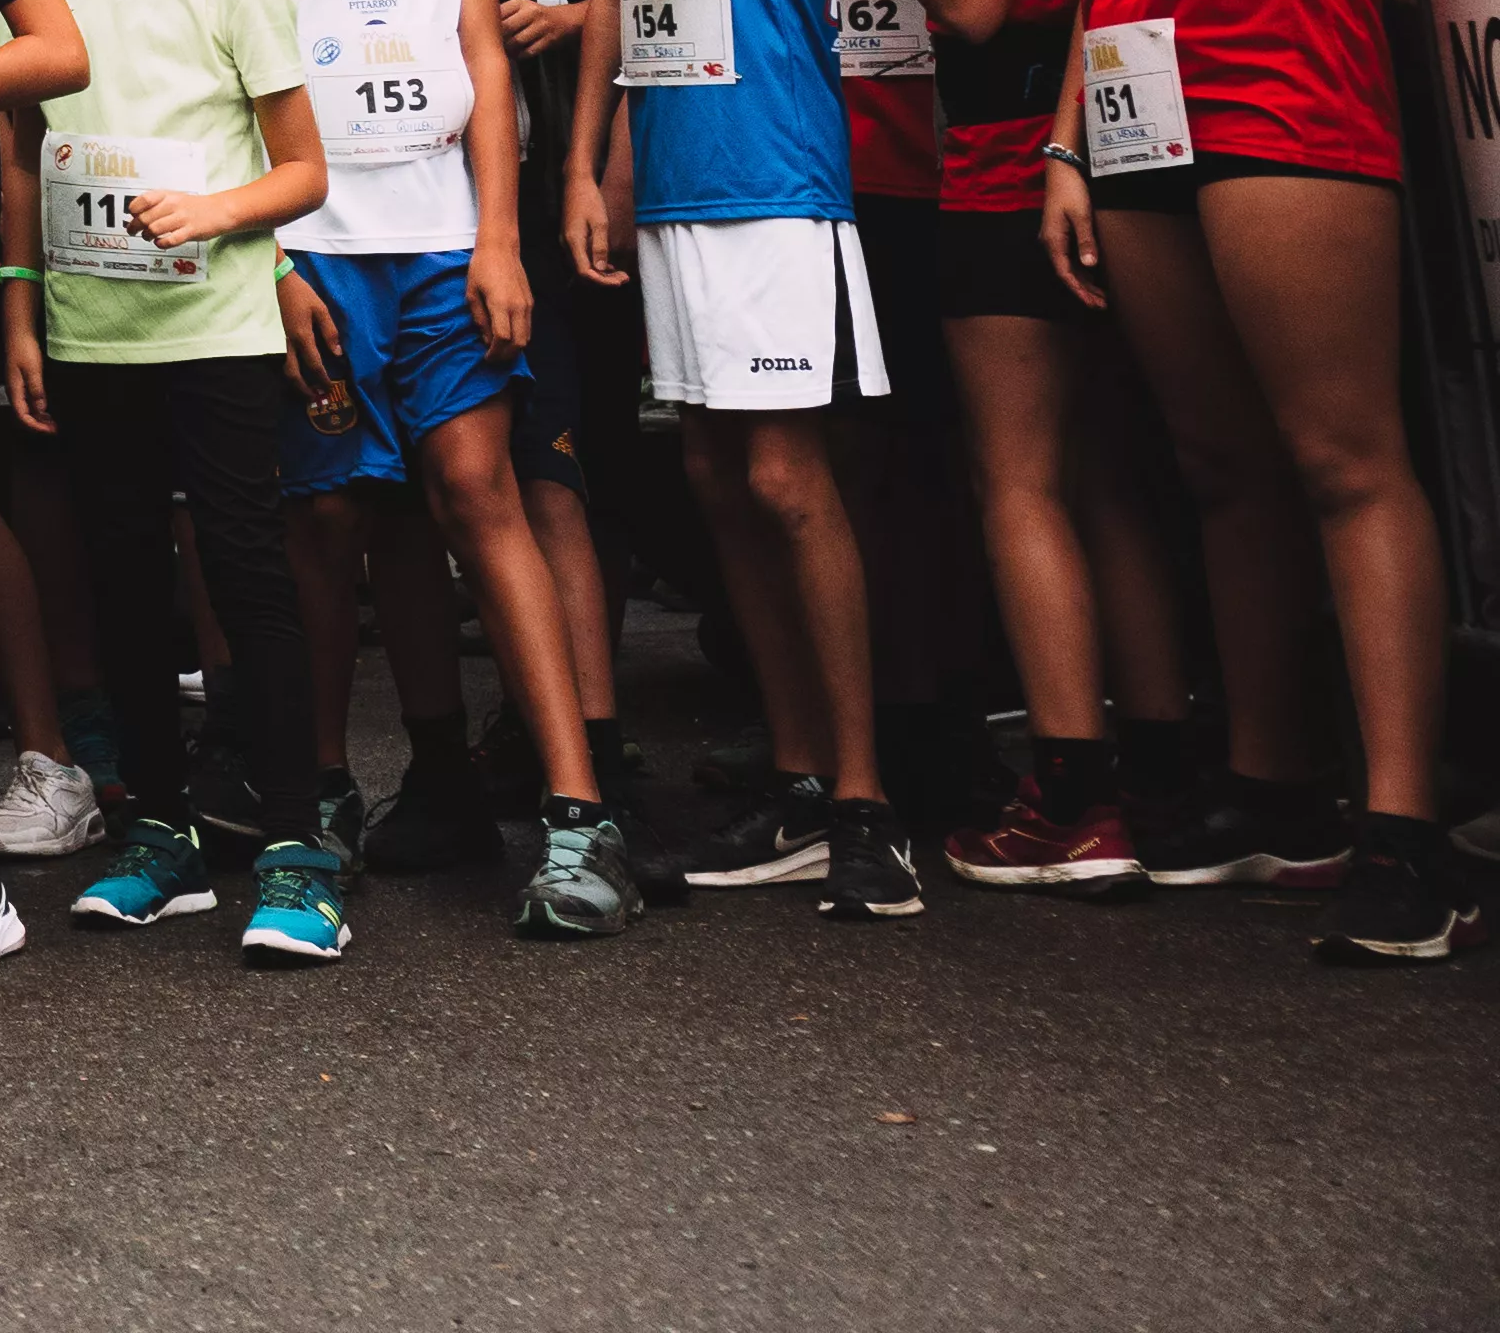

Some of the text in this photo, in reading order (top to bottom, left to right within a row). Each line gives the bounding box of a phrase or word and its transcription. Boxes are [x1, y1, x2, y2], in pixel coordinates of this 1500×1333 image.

[632, 3, 678, 38] 154
[364, 39, 417, 64] TRAIL
[355, 78, 428, 114] 153
[1094, 83, 1138, 124] 151
[84, 152, 140, 178] TRAIL
[1067, 836, 1101, 860] EVADICT
